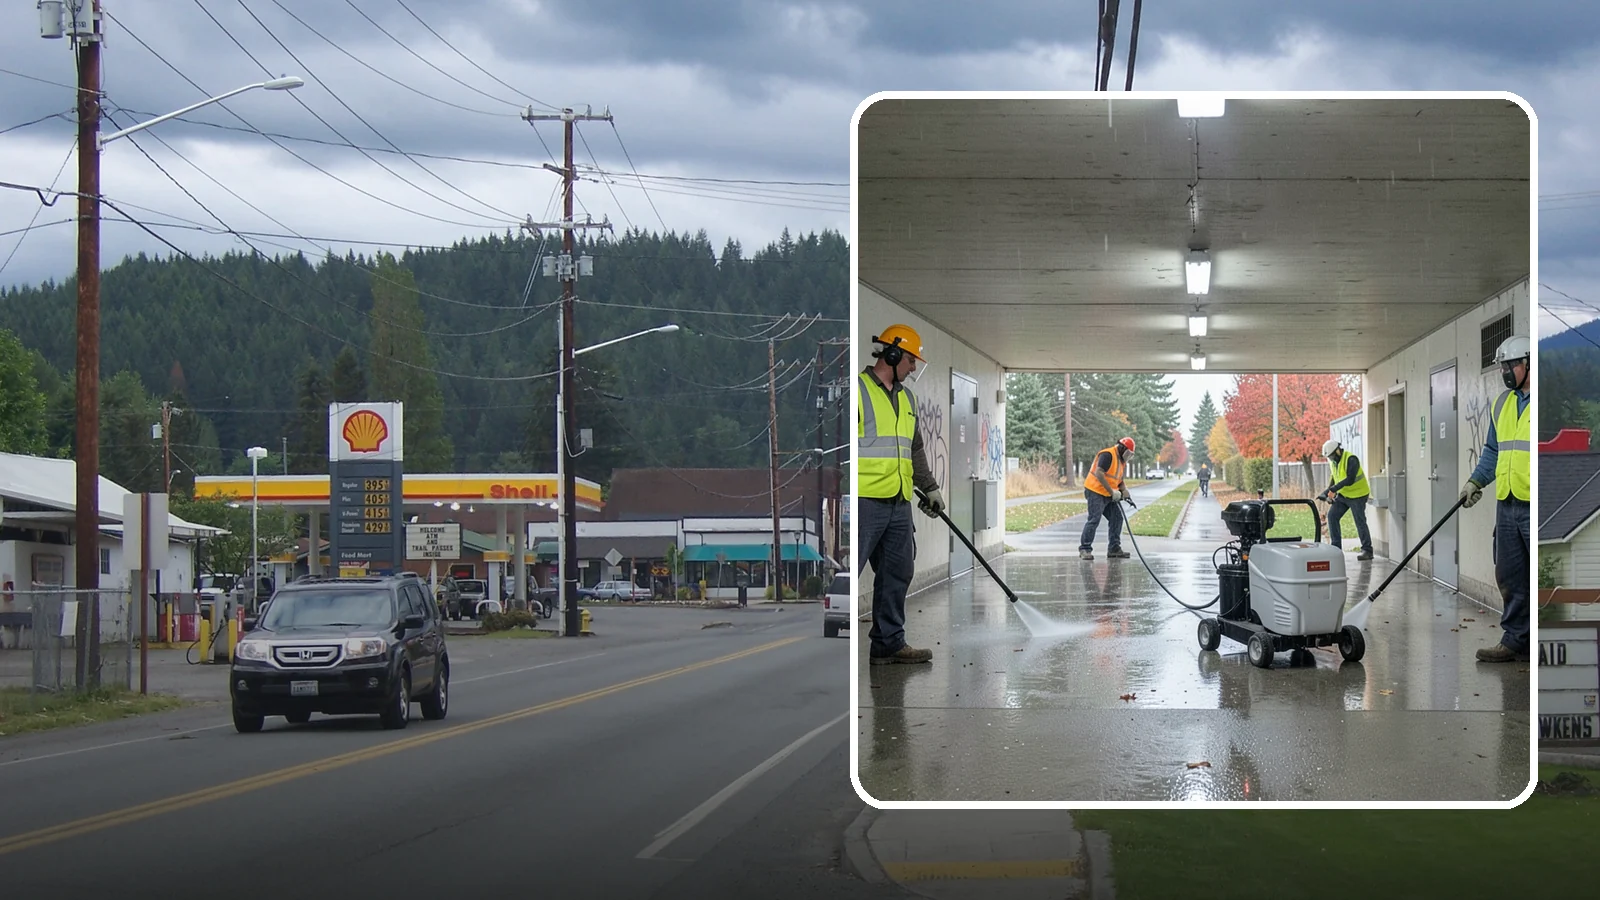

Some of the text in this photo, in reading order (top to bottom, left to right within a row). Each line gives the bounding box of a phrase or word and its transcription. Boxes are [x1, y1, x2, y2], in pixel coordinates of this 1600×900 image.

[365, 480, 383, 490] 395
[490, 484, 547, 499] Shell
[365, 494, 383, 504] 405
[365, 508, 383, 518] 415
[365, 522, 383, 533] 429
